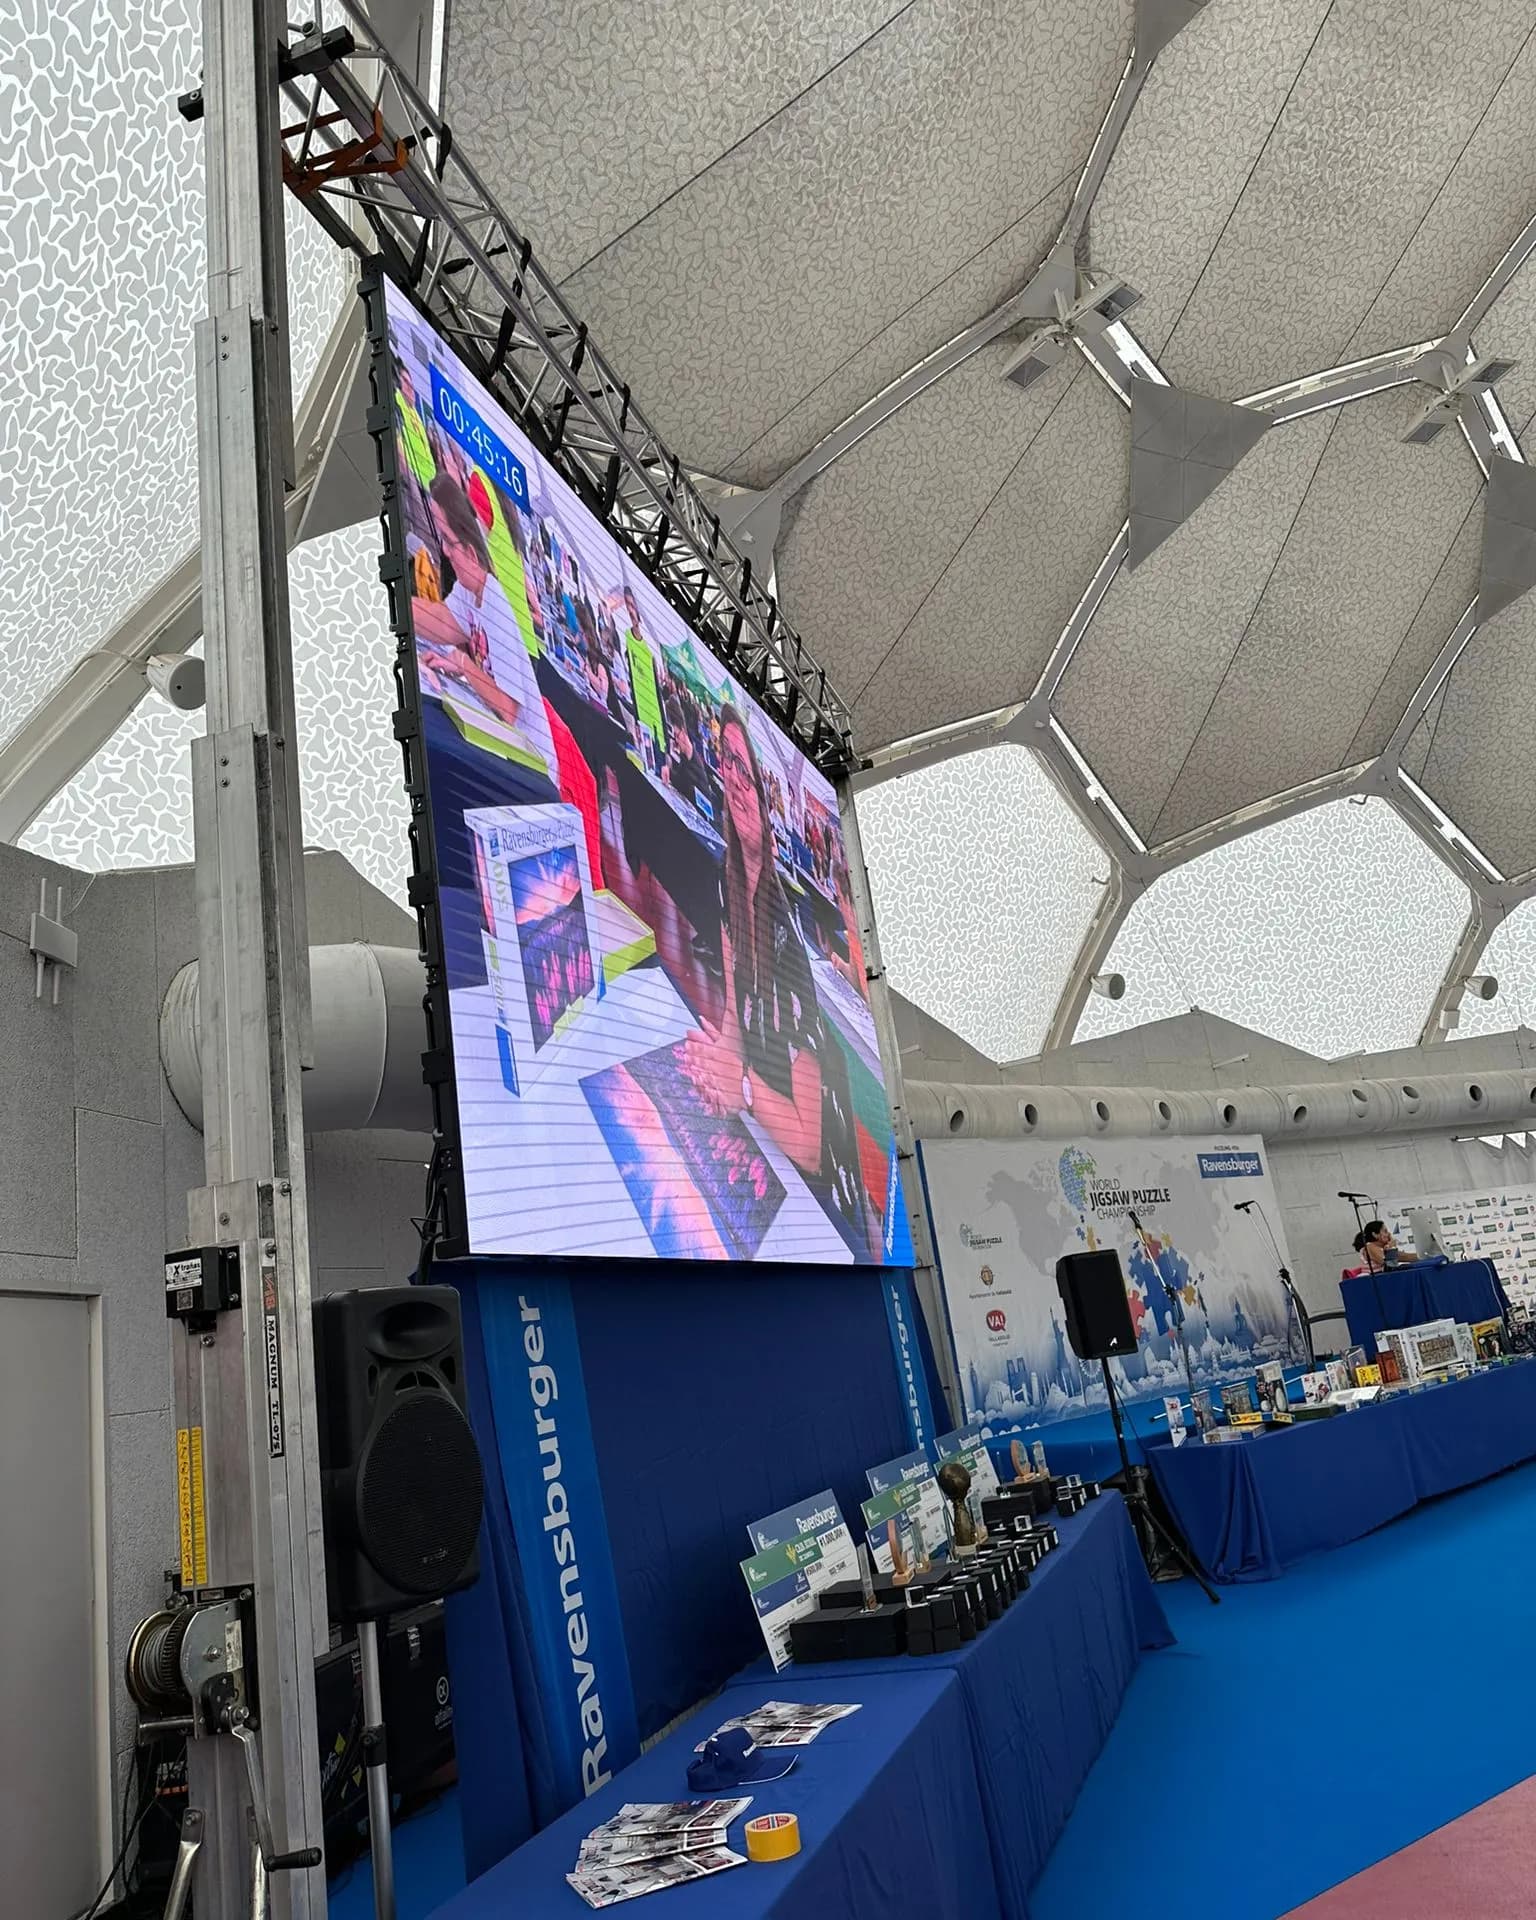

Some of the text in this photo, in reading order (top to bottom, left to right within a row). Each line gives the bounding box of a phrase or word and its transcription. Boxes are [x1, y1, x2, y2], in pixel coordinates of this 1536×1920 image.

[440, 388, 523, 497] 00:45:16
[1089, 1178, 1121, 1191] WORLD
[1202, 1158, 1259, 1174] Ravensburger
[1089, 1188, 1171, 1211] JIGSAW PUZZLE
[266, 1319, 278, 1389] MAGNUM
[891, 1285, 925, 1450] nsburger
[796, 1506, 838, 1535] Ravensburger
[519, 1295, 613, 1799] Ravensburger
